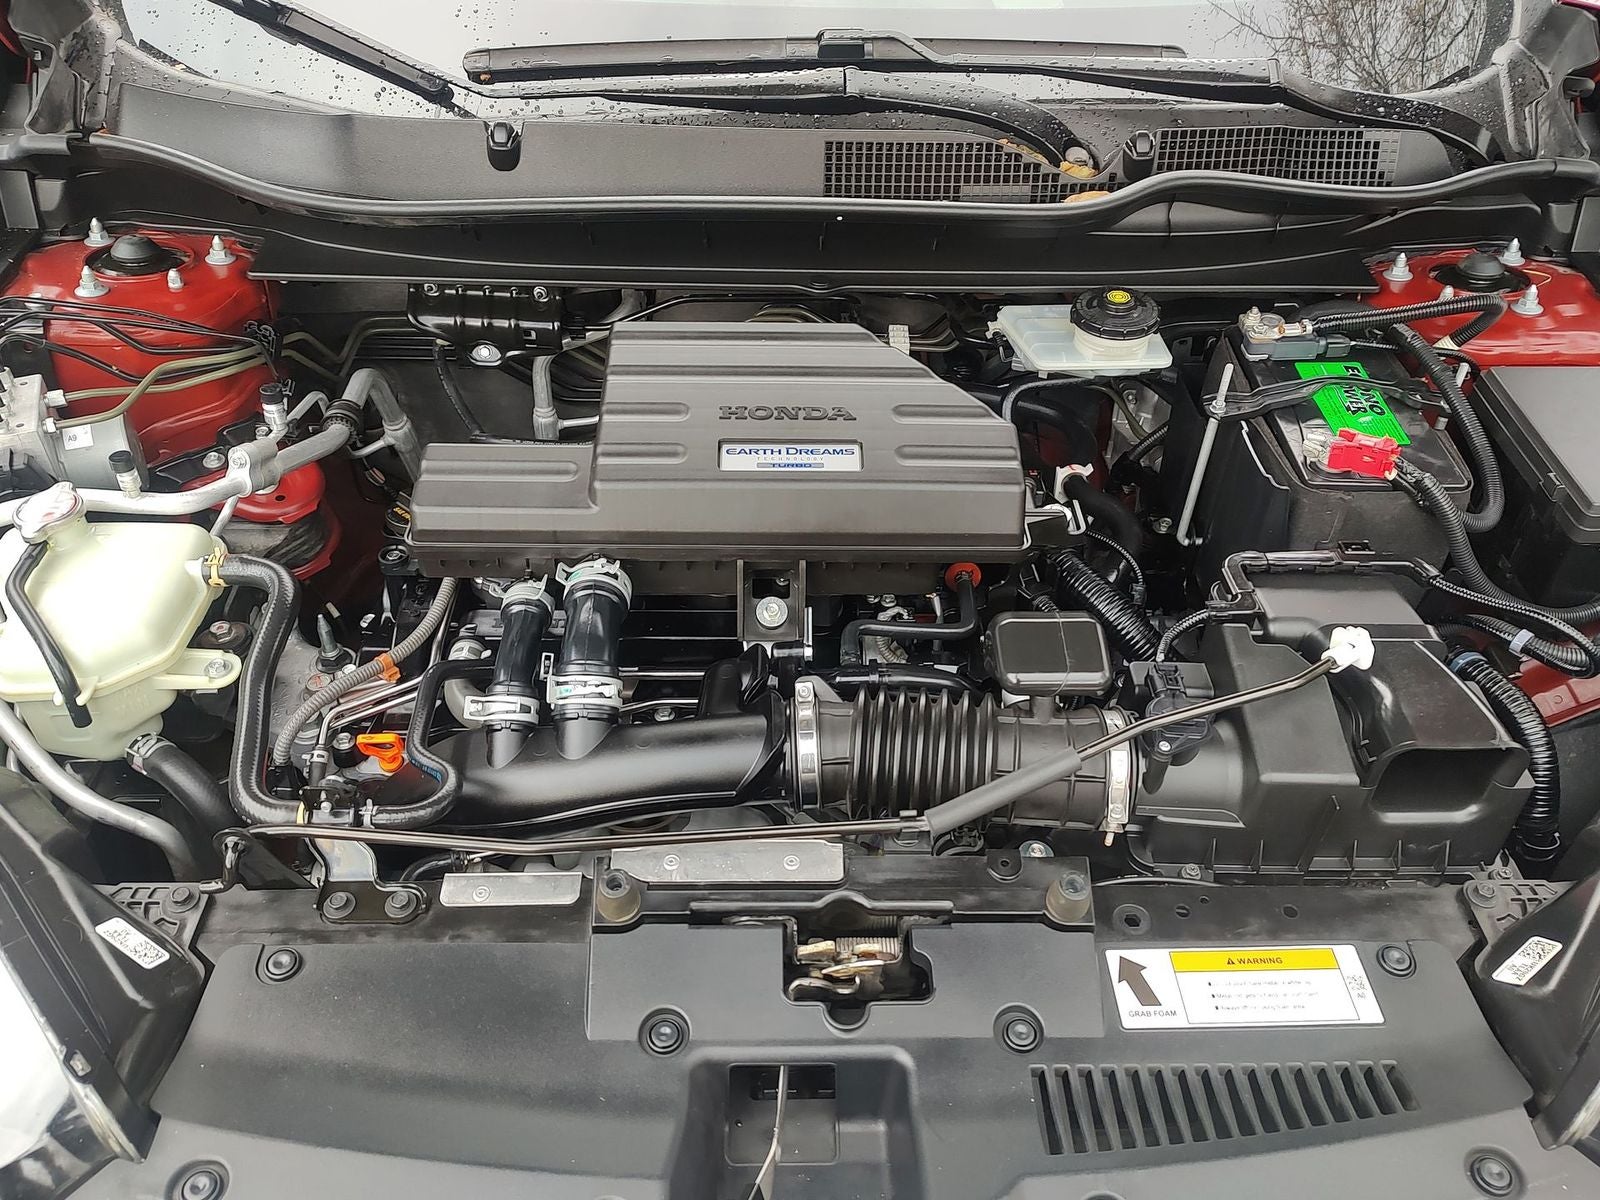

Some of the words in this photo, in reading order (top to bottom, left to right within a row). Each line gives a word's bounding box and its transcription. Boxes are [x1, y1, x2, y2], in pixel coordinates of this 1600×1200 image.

[719, 406, 857, 420] HONDA
[785, 447, 855, 455] DREAMS
[1237, 957, 1283, 965] WARNING
[1129, 1010, 1150, 1018] GRAB
[1153, 1009, 1178, 1017] FOAM
